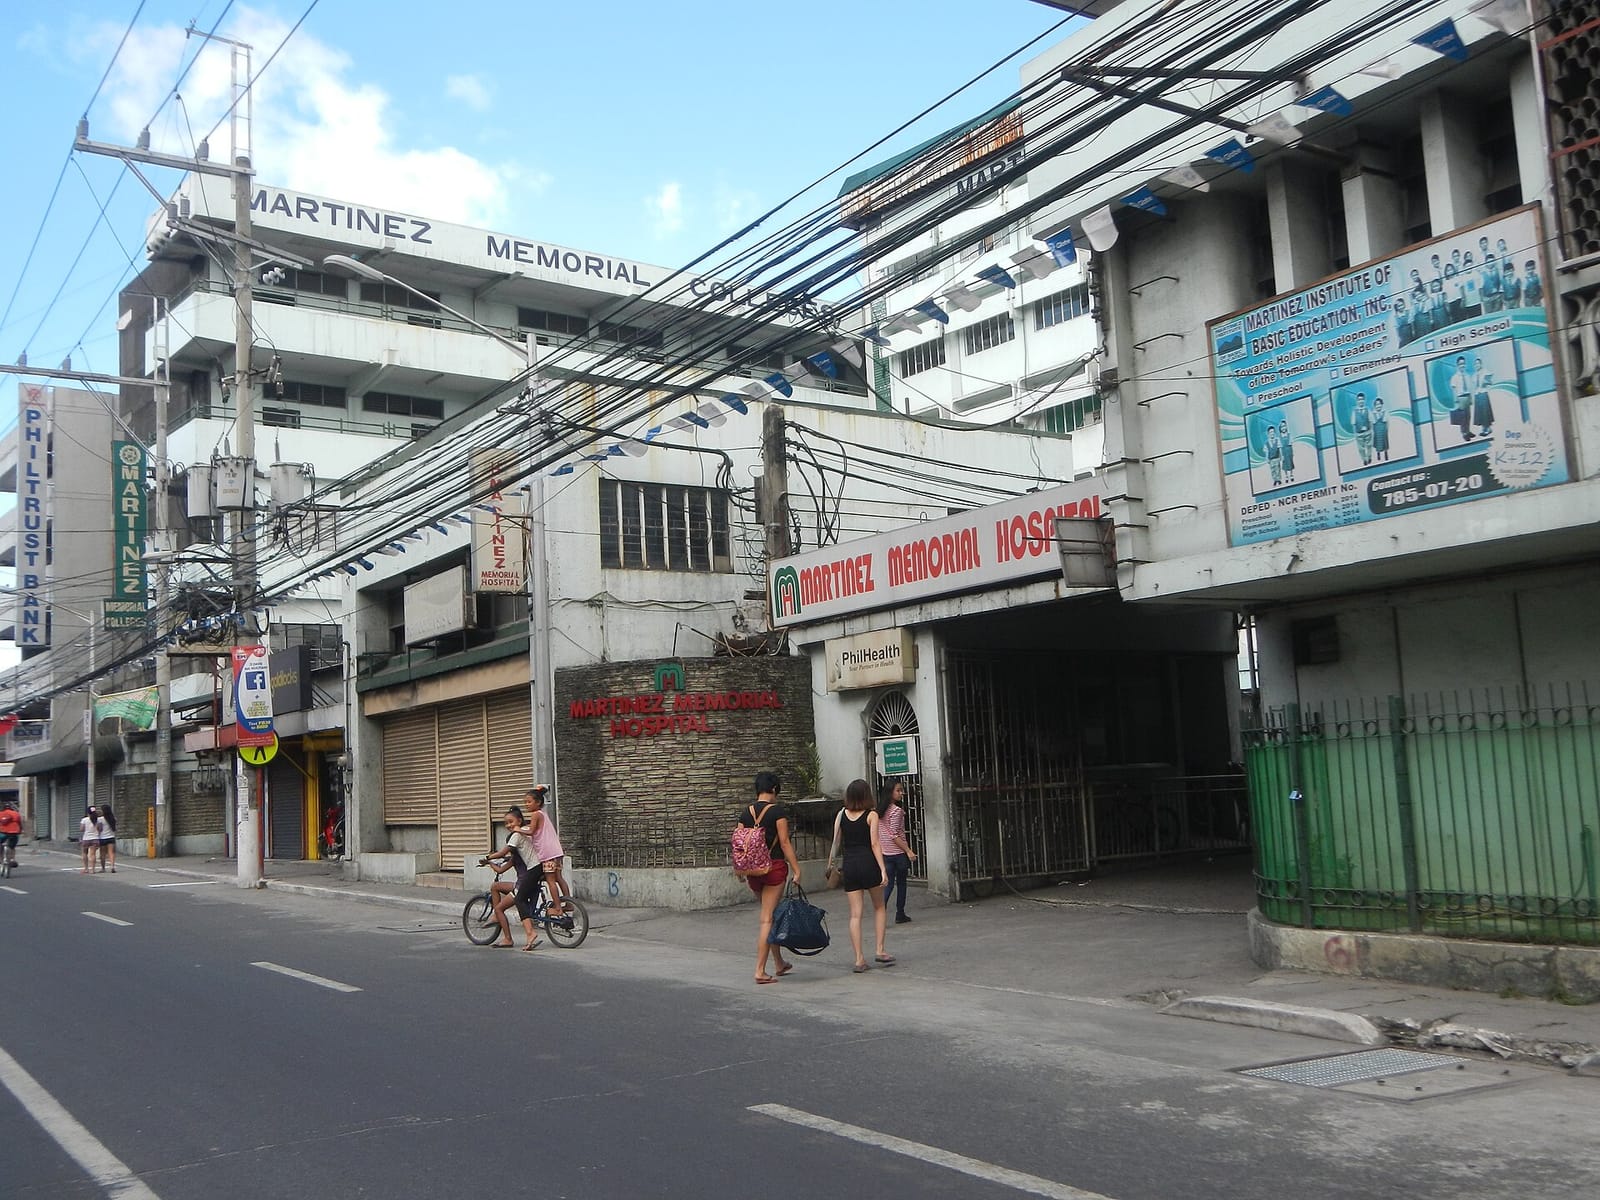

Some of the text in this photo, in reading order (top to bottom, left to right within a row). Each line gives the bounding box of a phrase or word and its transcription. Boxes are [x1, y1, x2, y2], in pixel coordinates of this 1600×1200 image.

[250, 189, 432, 245] MARTINEZ
[487, 235, 651, 287] MEMORIAL
[1246, 264, 1391, 332] MARTINEZ INSTITUTE OF
[1252, 328, 1286, 355] BASIC
[1364, 294, 1392, 318] INC.
[1440, 319, 1511, 349] High School
[1276, 347, 1313, 365] Holistic
[1316, 322, 1386, 351] Development
[1249, 379, 1259, 388] of
[1260, 374, 1275, 386] the
[1279, 353, 1336, 378] Tomorrow's
[1343, 352, 1402, 377] Elementary
[1258, 382, 1303, 403] Preschool
[24, 408, 42, 568] PHILTRUST
[1241, 501, 1271, 516] DEPED
[1278, 494, 1299, 507] NCR
[1301, 486, 1337, 502] PERMIT
[1341, 483, 1358, 493] No.
[1372, 475, 1412, 491] Contact
[1382, 474, 1483, 507] 785-07-20
[122, 465, 140, 594] MARTINEZ
[799, 495, 1100, 606] MARTINEZ MEMORIAL HOSP
[481, 571, 520, 579] MEMORIAL
[481, 578, 520, 587] HOSPITAL
[24, 575, 41, 643] BANK
[842, 643, 900, 666] PhilHealth
[570, 690, 784, 719] MARTINEZ MEMORIAL
[610, 714, 713, 738] HOSPITAL
